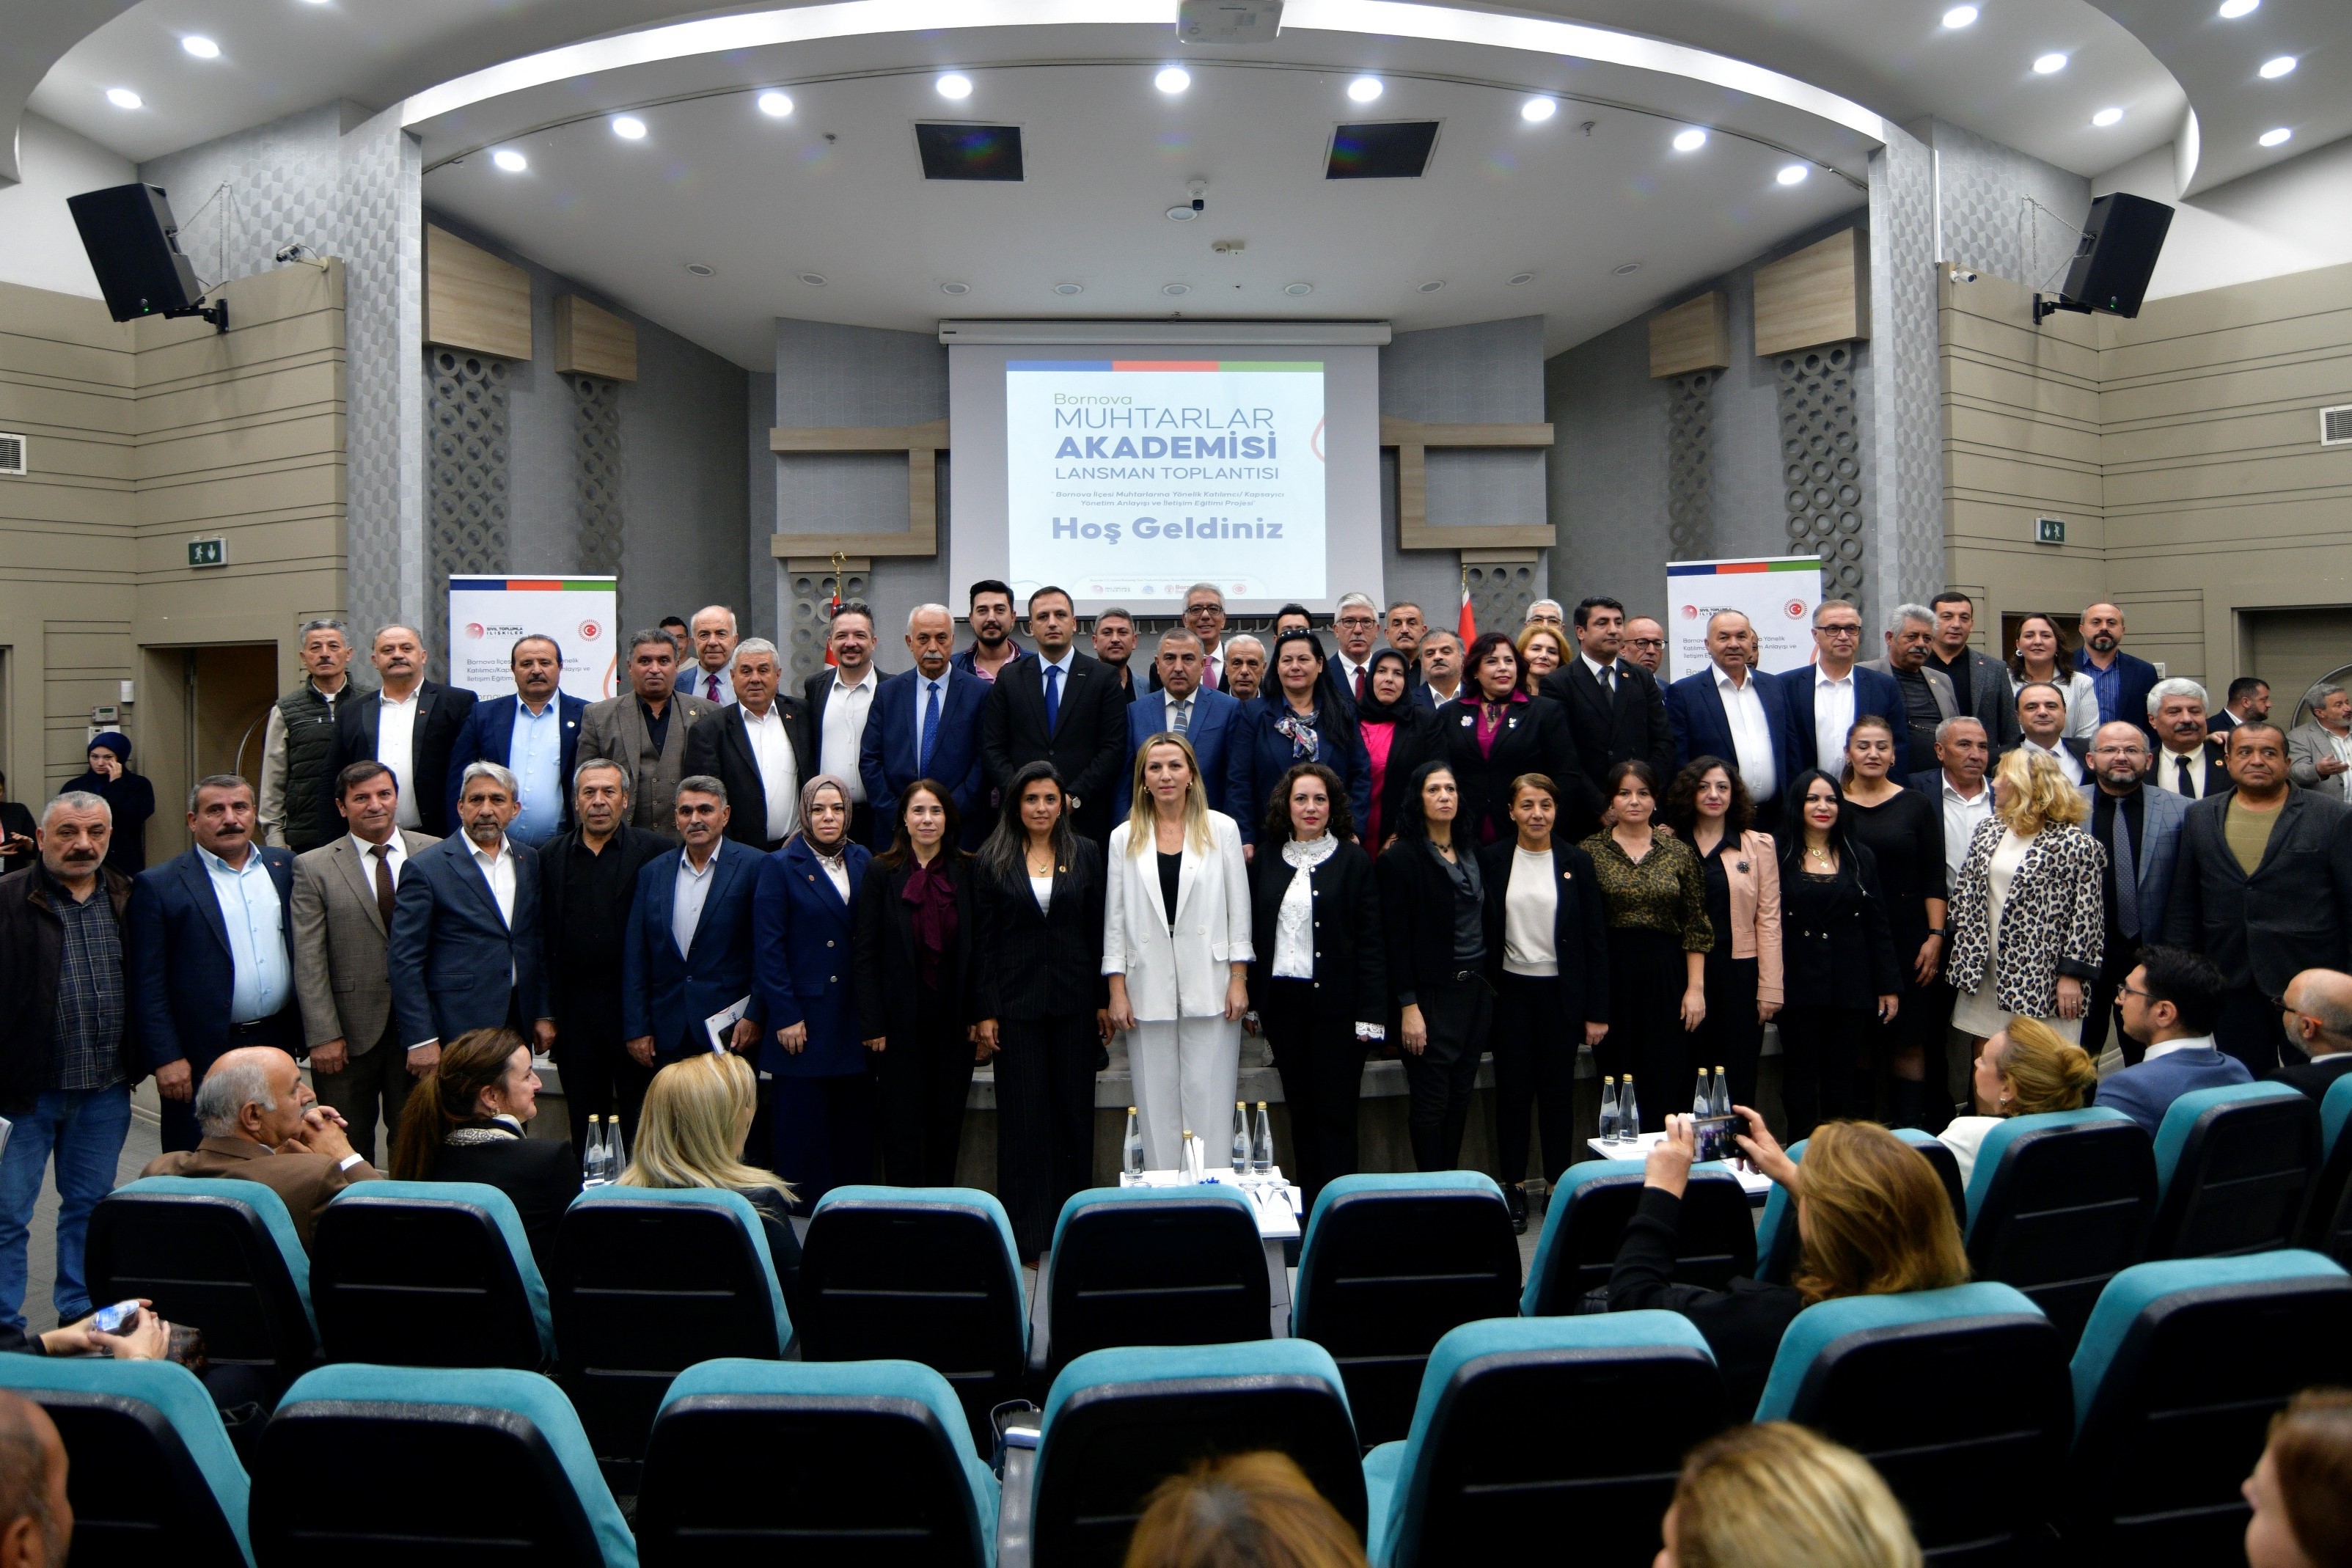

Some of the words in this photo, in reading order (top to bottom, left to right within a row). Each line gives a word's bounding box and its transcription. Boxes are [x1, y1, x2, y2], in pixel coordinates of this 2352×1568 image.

[1054, 393, 1132, 405] Bornova
[1055, 408, 1274, 429] MUHTARLAR
[1055, 431, 1276, 459] AKADEMİSİ
[1055, 467, 1155, 480] LANSMAN
[1160, 467, 1278, 480] TOPLANTISI
[1052, 516, 1122, 545] Hoş
[1132, 516, 1283, 539] Geldiniz
